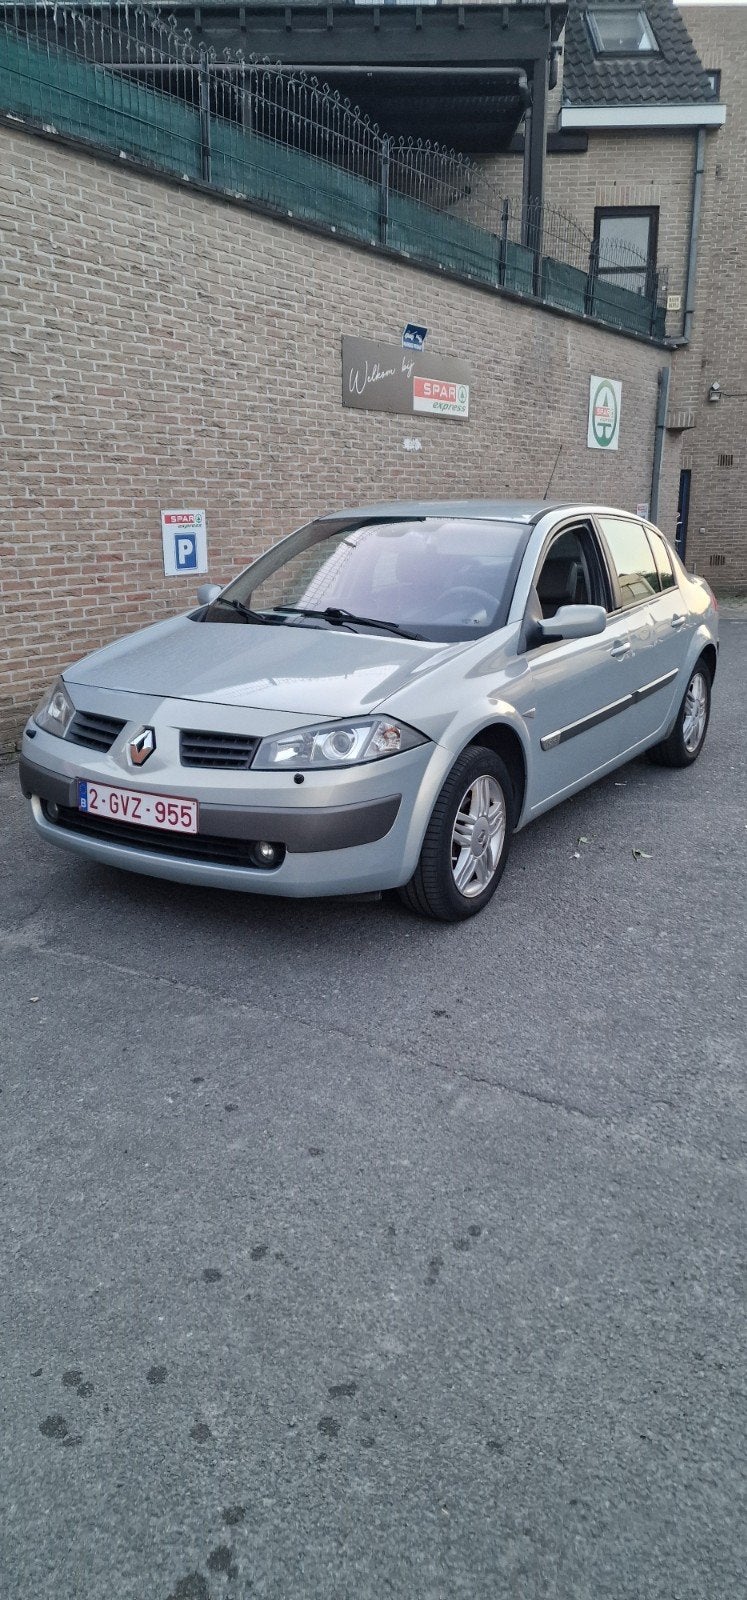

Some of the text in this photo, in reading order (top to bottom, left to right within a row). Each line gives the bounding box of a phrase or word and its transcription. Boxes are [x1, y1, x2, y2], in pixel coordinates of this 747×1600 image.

[348, 356, 415, 394] Welkom bij
[423, 382, 456, 399] SPAR
[432, 402, 466, 412] express
[170, 515, 194, 523] SPAR
[178, 539, 194, 565] P
[80, 788, 192, 828] B 2-GVZ-955
